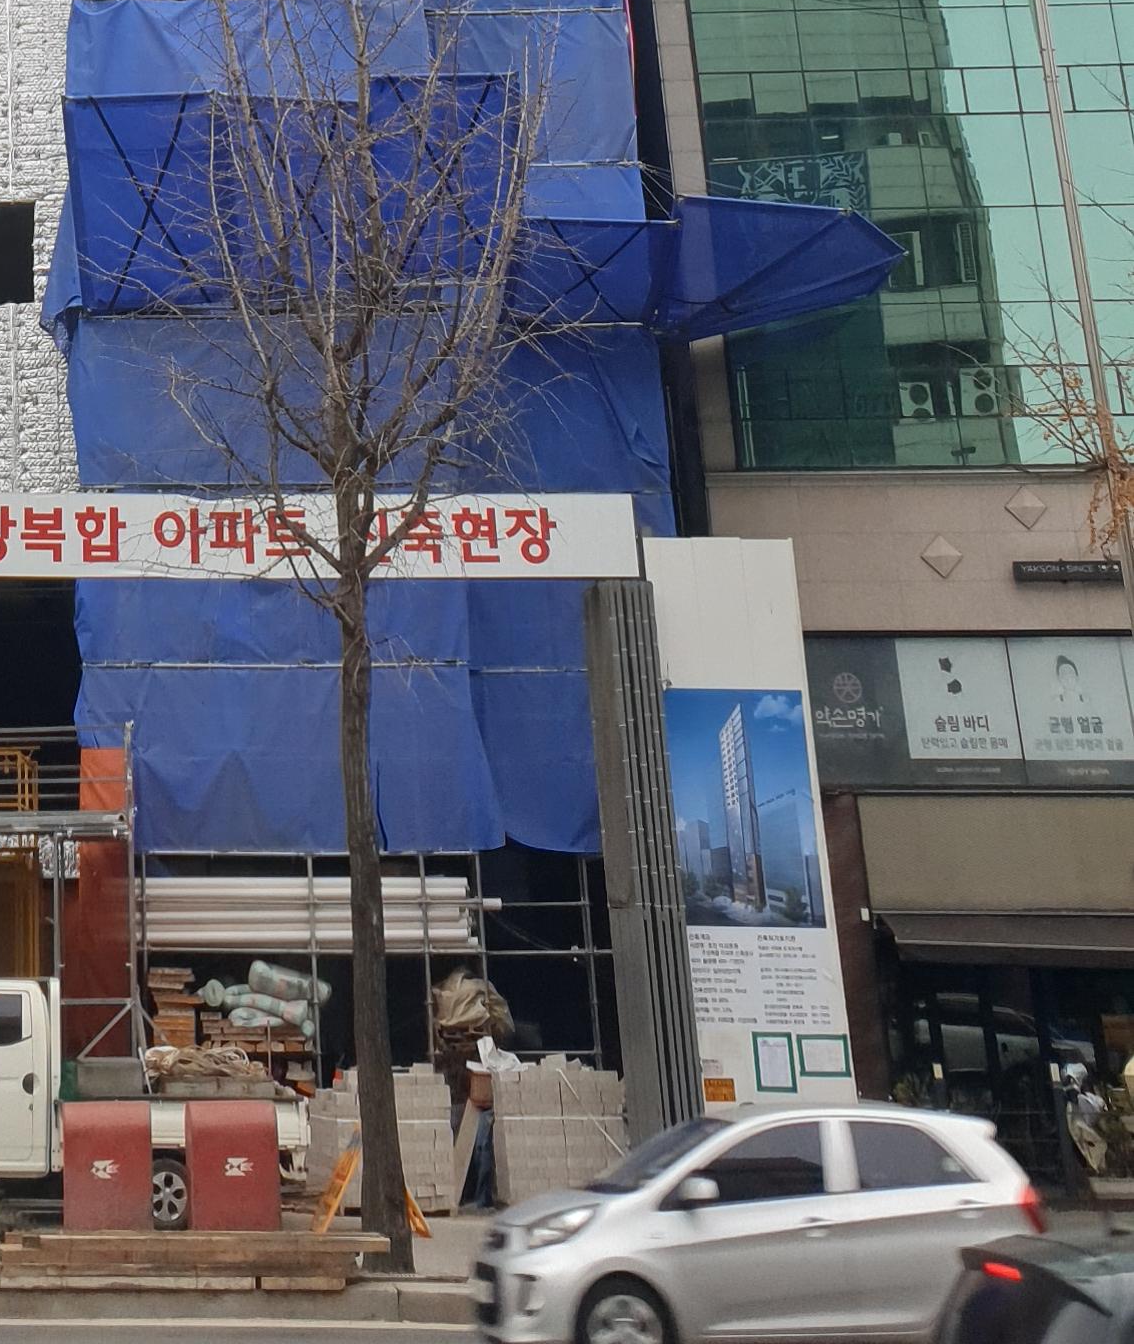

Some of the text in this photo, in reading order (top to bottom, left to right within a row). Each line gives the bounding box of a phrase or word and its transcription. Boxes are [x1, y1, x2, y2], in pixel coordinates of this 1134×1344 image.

[153, 507, 312, 565] 아파트
[935, 715, 990, 732] 슬림 바디
